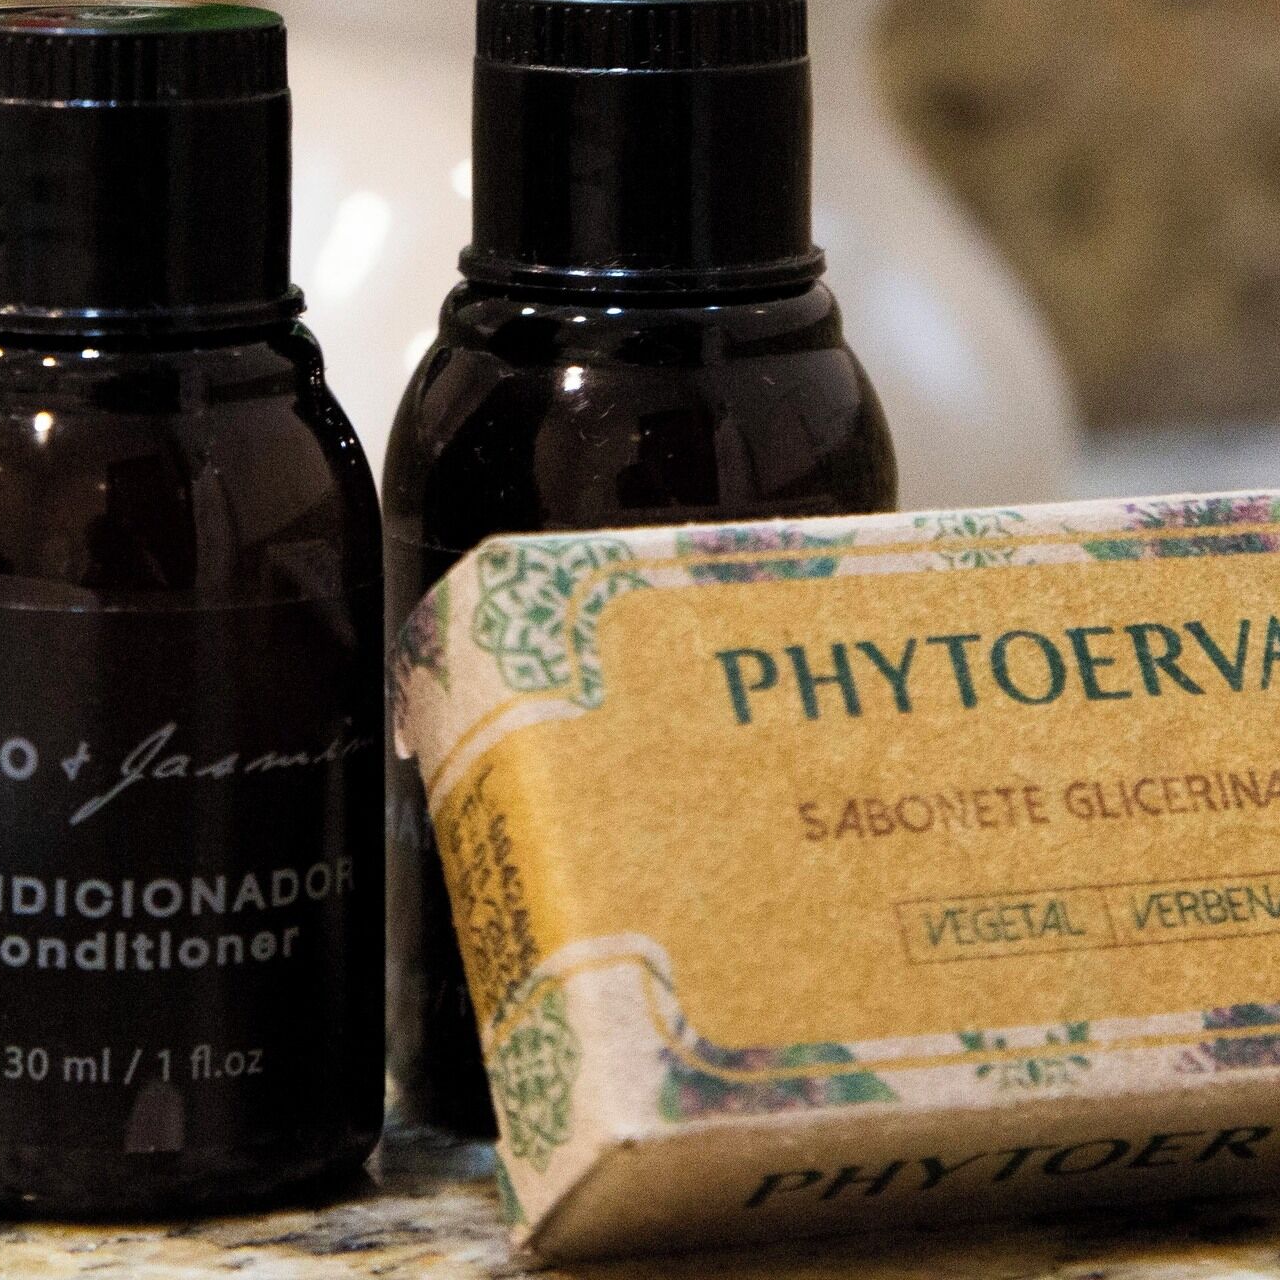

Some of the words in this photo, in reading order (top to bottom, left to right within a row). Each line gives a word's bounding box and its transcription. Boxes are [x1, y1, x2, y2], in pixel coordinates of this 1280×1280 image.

[798, 784, 1051, 842] SABONETE
[925, 899, 1087, 947] VEGETAL
[3, 1045, 50, 1081] 30
[63, 1047, 110, 1083] ml
[158, 1049, 171, 1083] 1
